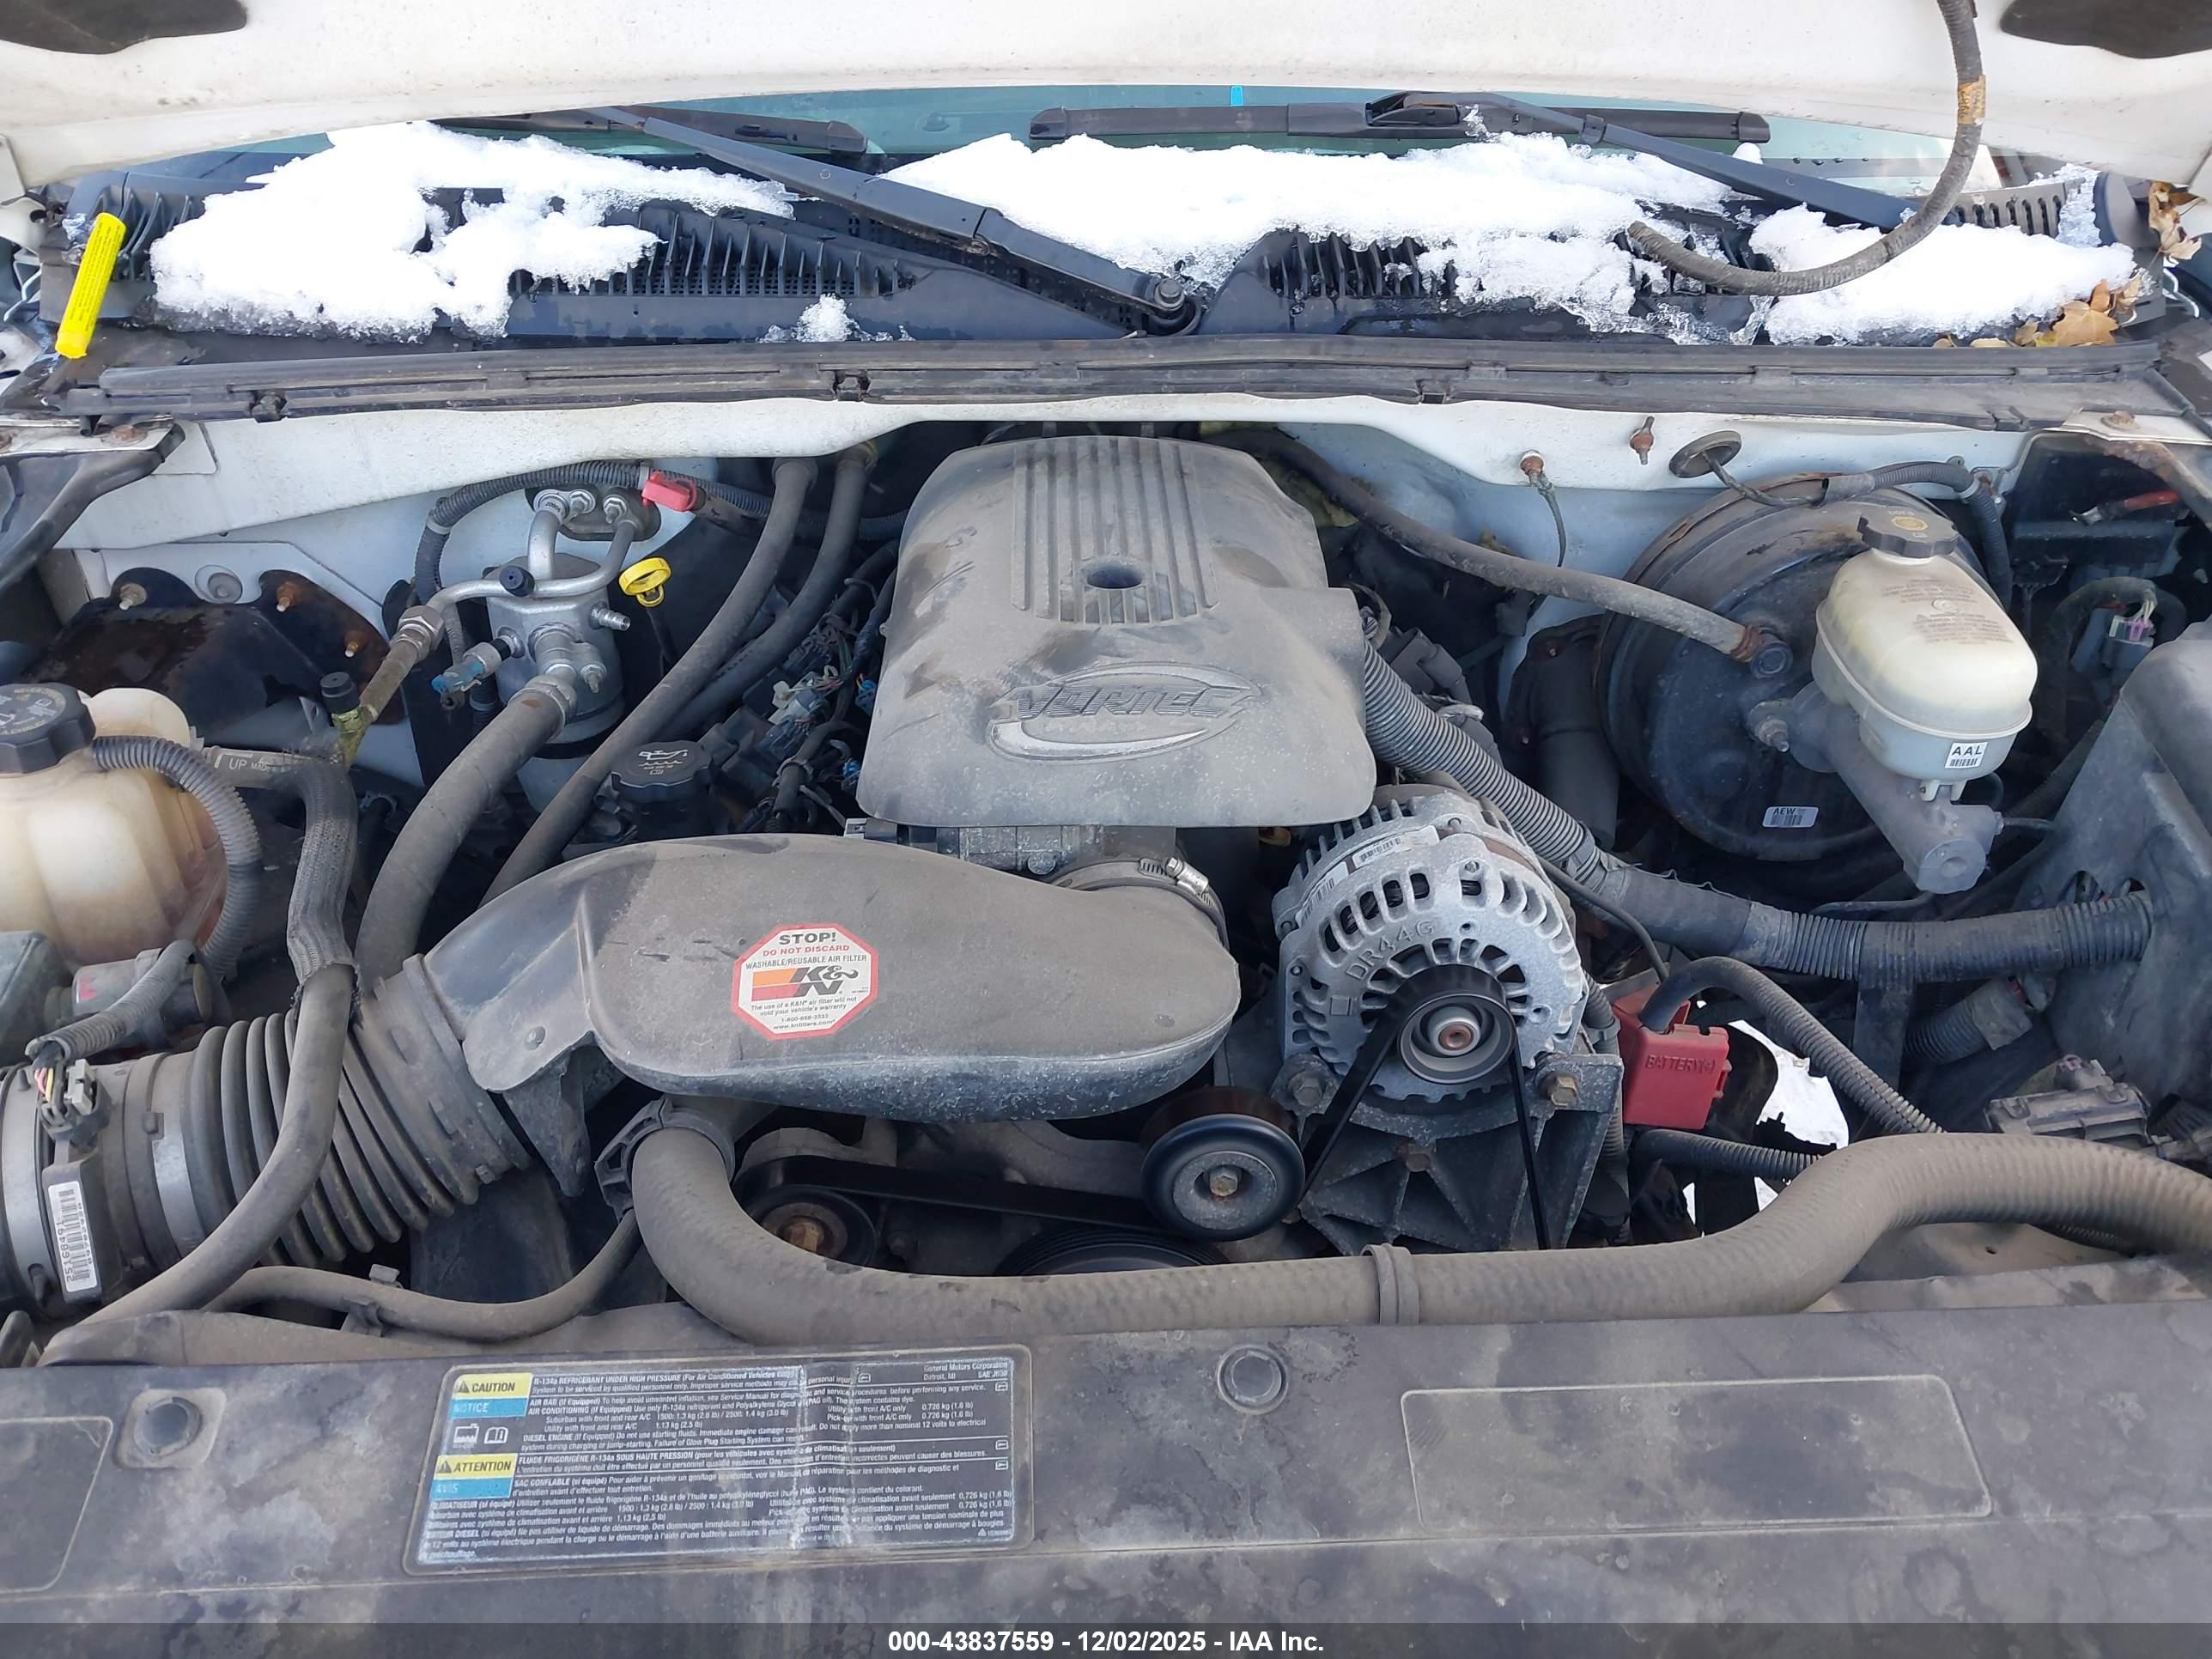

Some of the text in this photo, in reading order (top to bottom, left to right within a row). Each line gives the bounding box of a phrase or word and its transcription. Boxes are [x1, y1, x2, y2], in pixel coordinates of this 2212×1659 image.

[1017, 685, 1231, 720] VORTEC
[1952, 745, 1982, 756] AAL
[229, 758, 247, 769] UP
[779, 932, 836, 945] STOP!
[1346, 921, 1433, 979] DR44G
[745, 956, 827, 969] WASHABLE/REUSABLE
[57, 1221, 74, 1282] 25168491
[972, 1362, 1007, 1370] Corporation
[472, 1382, 515, 1392] CAUTION
[912, 1384, 947, 1395] performing
[453, 1403, 489, 1413] NOTICE
[453, 1461, 511, 1472] ATTENTION
